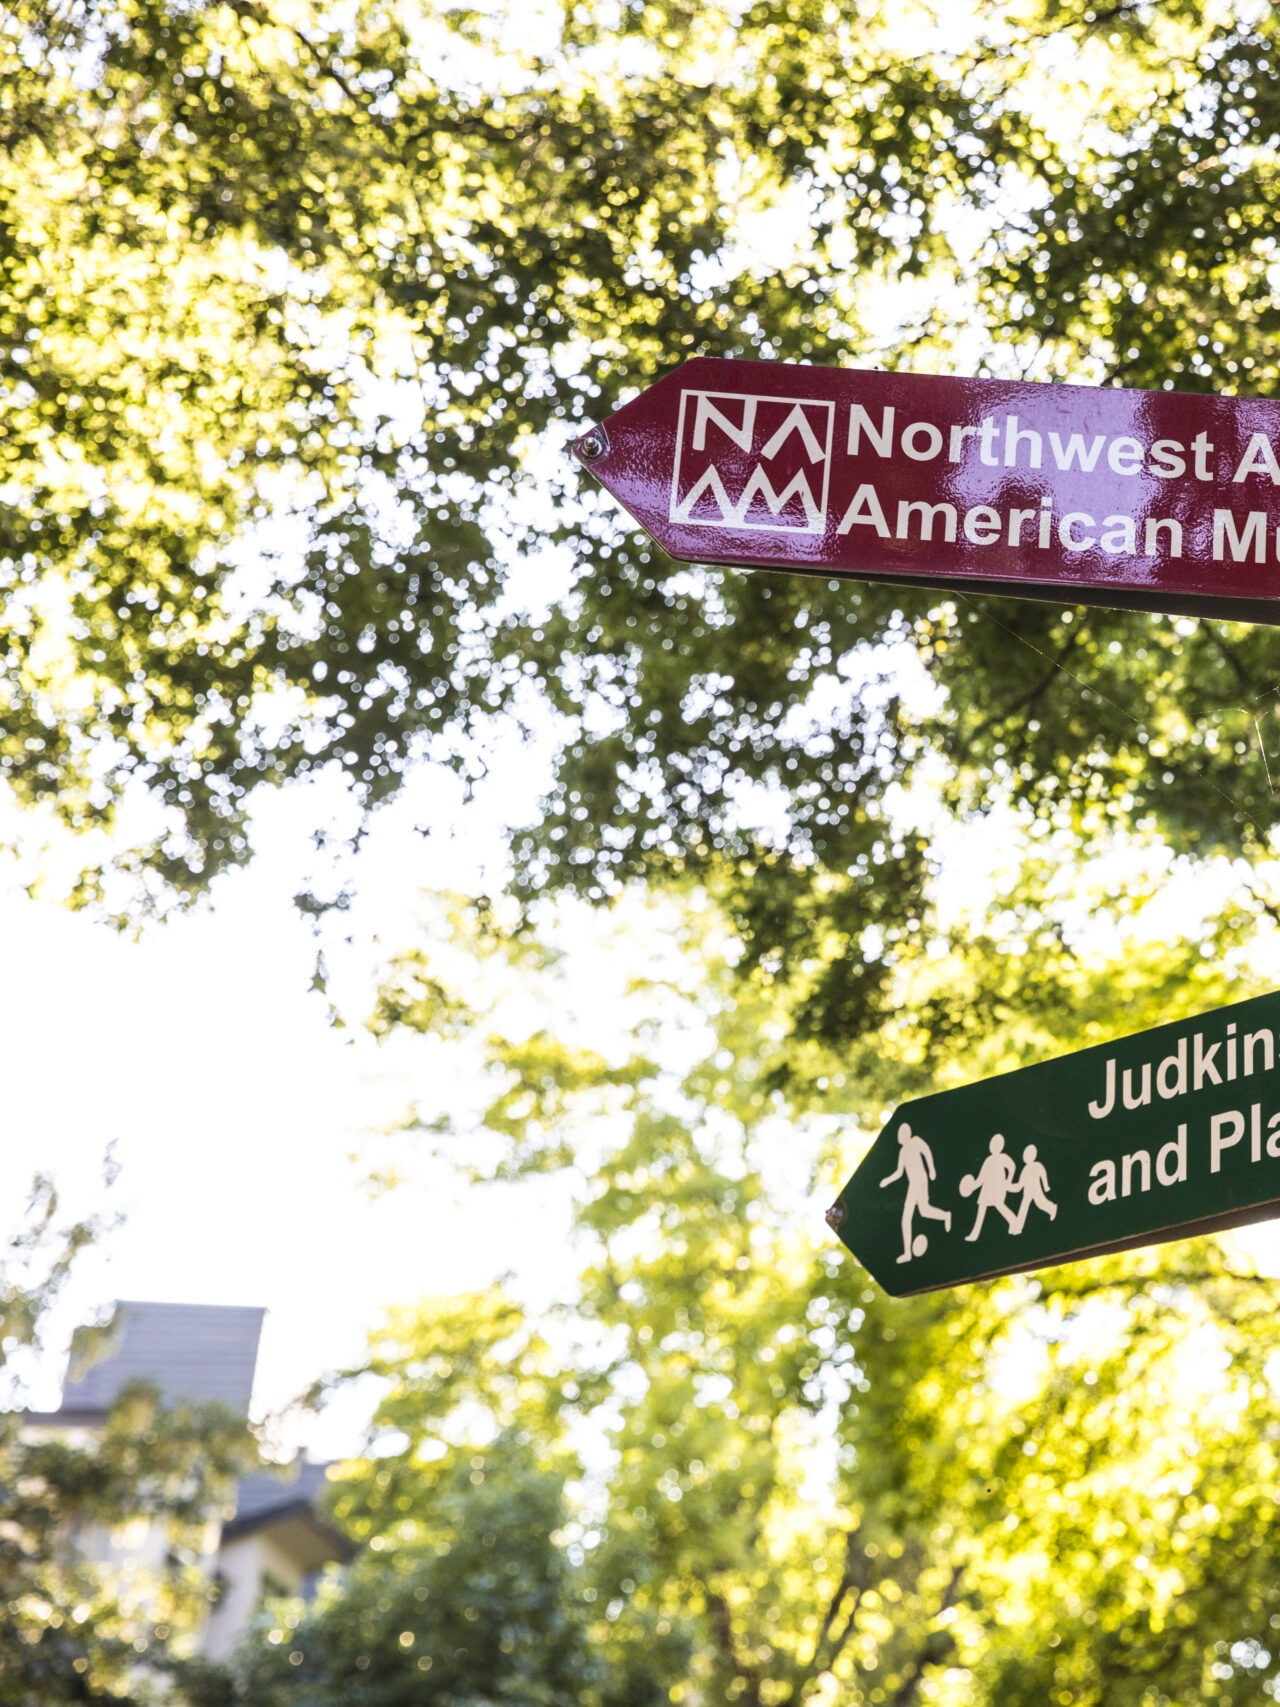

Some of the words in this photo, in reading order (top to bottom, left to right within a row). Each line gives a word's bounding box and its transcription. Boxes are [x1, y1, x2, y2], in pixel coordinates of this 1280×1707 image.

[847, 404, 1216, 482] Northwest
[836, 482, 1184, 559] American
[1087, 1125, 1188, 1206] and
